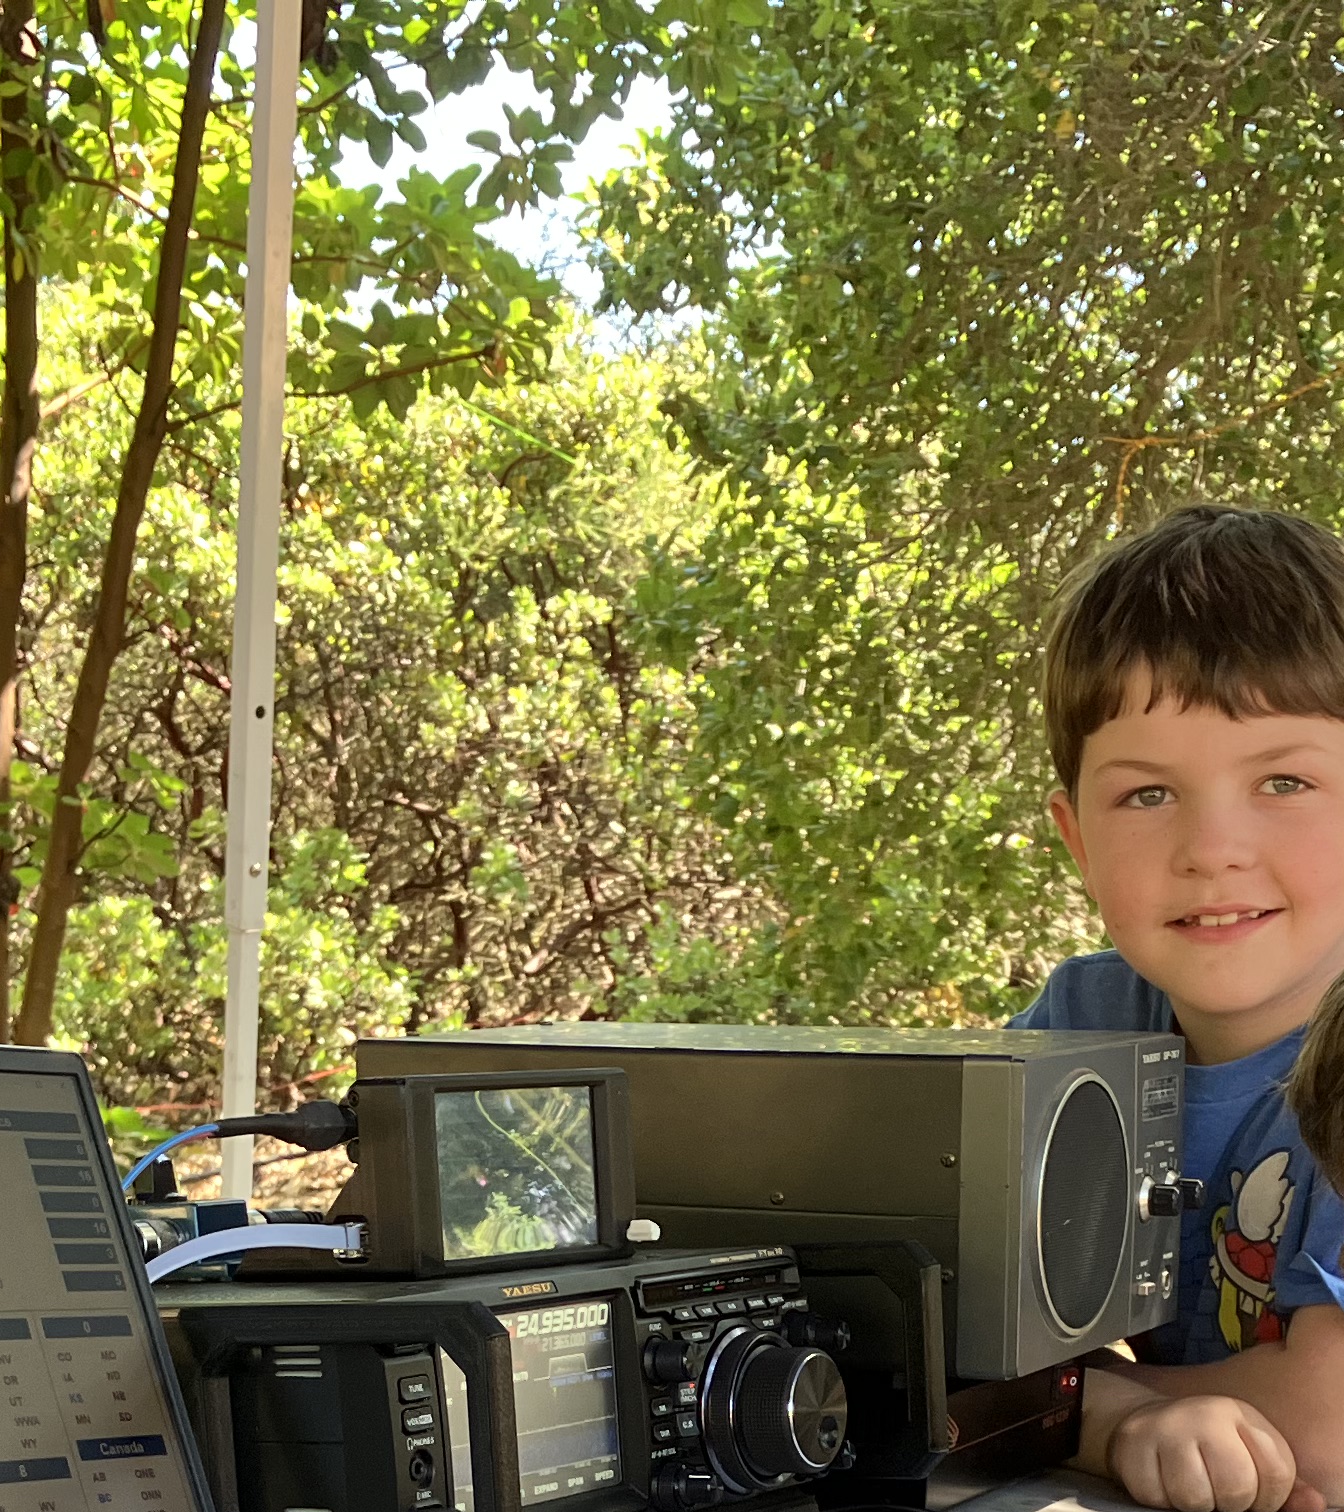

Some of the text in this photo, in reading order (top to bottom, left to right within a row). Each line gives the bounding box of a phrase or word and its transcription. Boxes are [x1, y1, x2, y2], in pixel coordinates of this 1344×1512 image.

[503, 1283, 551, 1297] YAESU
[516, 1304, 608, 1338] 24.935.000
[100, 1441, 144, 1455] Canada
[19, 1465, 27, 1478] 8
